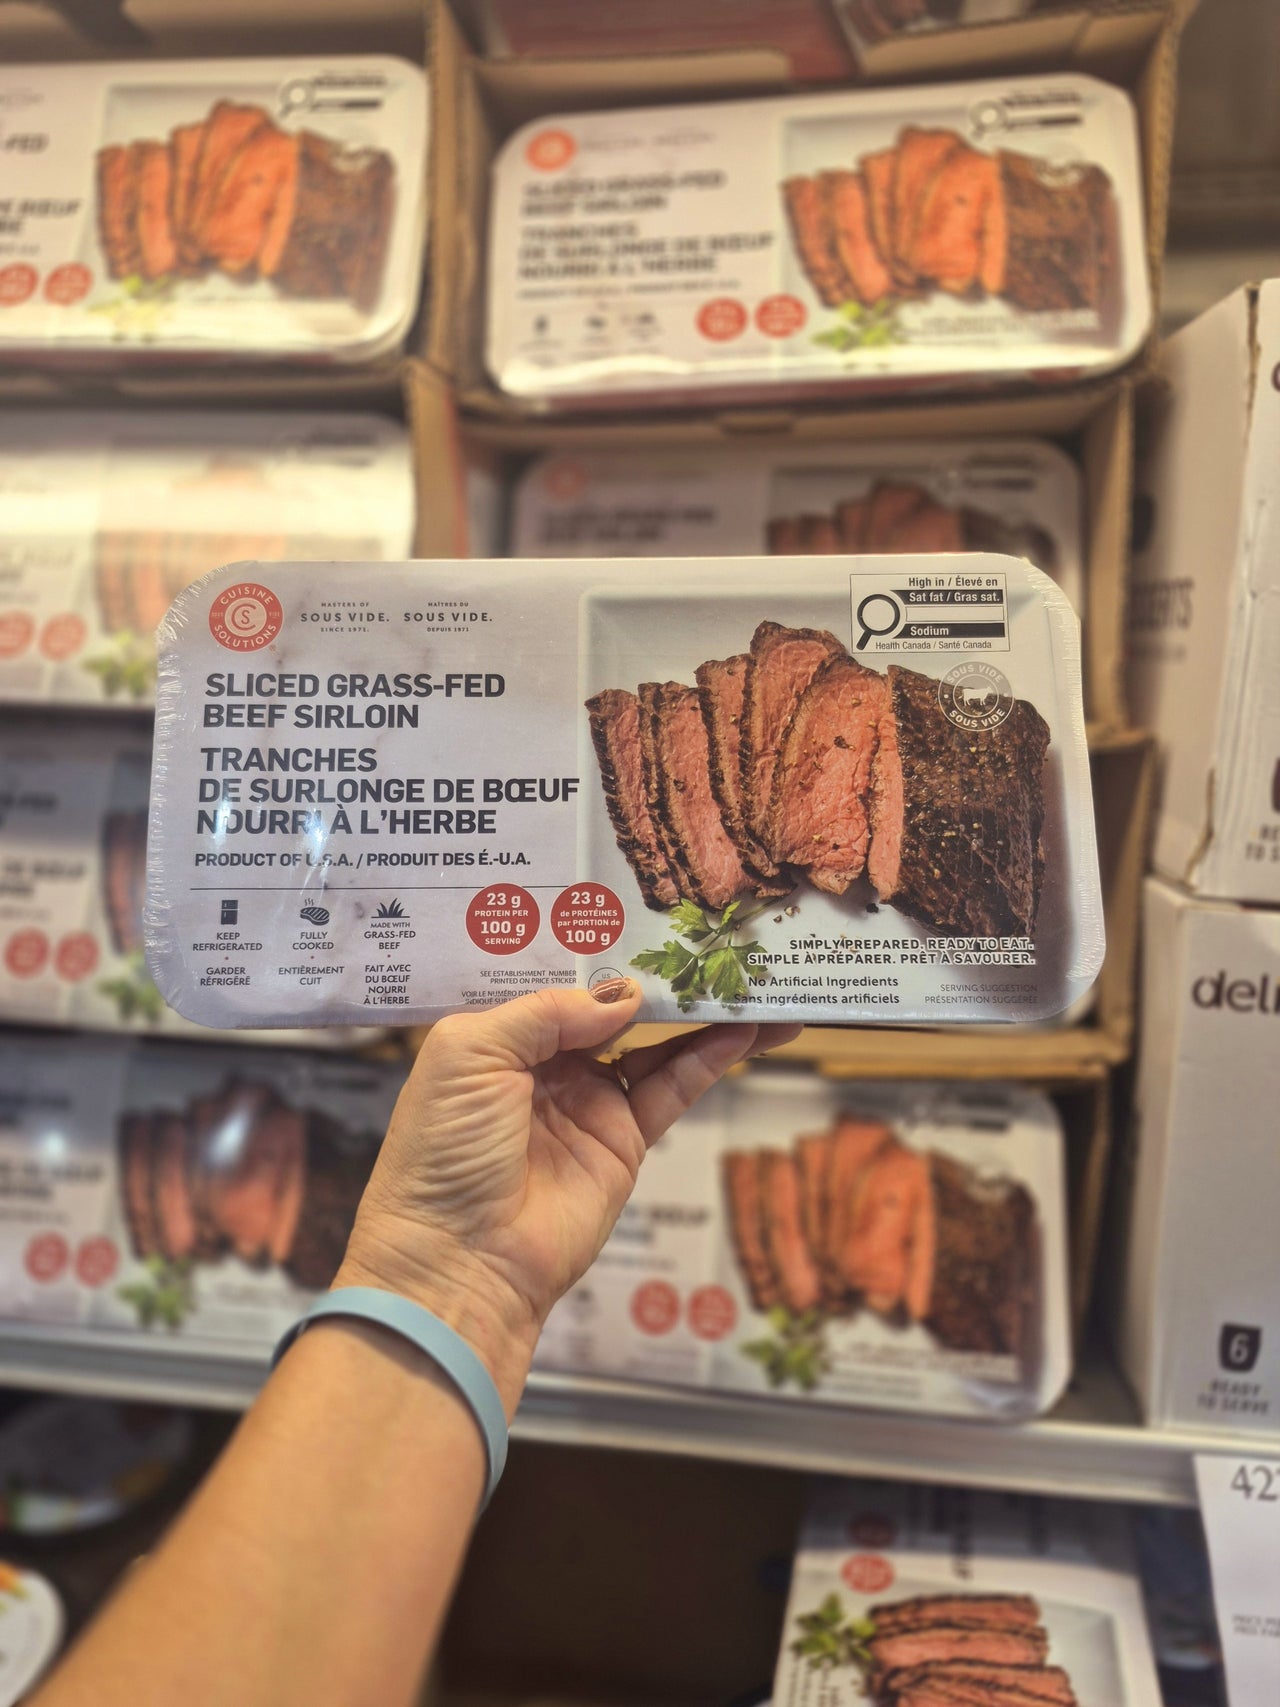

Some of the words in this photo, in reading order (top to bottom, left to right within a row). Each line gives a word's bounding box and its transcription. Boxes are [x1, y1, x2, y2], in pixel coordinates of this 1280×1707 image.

[909, 578, 932, 589] High
[935, 578, 945, 587] in
[956, 575, 982, 587] Élevé
[986, 579, 998, 587] en
[220, 586, 274, 605] CUISINE
[909, 592, 927, 602] Sat
[930, 592, 944, 602] fat
[954, 592, 978, 602] Gras
[980, 592, 1000, 602] sat.
[300, 612, 342, 622] SOUS
[348, 612, 390, 622] VIDE.
[404, 612, 446, 622] SOUS
[452, 612, 494, 622] VIDE.
[910, 626, 950, 636] Sodium
[214, 624, 277, 649] SOLUTIONS
[876, 642, 900, 650] Health
[902, 642, 931, 650] Canada
[938, 640, 961, 650] Santé
[963, 641, 992, 650] Canada
[946, 664, 975, 684] SOUS
[978, 664, 1004, 684] VIDE
[205, 673, 320, 698] SLICED
[327, 674, 506, 698] GRASS-FED
[204, 704, 287, 728] BEEF
[293, 704, 419, 729] SIRLOIN
[950, 710, 978, 728] SOUS
[981, 708, 1006, 727] VIDE
[201, 748, 378, 772] TRANCHES
[199, 779, 242, 803] DE
[249, 779, 425, 803] SURLONGE
[434, 779, 475, 803] DE
[483, 778, 580, 803] BŒUF
[330, 804, 353, 834] À
[360, 810, 496, 834] L'HERBE
[195, 853, 276, 867] PRODUCT
[280, 854, 302, 866] OF
[367, 853, 440, 866] PRODUIT
[443, 853, 475, 866] DES
[479, 849, 532, 866] É.-U.A.
[486, 893, 507, 906] 23
[511, 895, 521, 908] g
[571, 892, 591, 905] 23
[595, 894, 606, 908] g
[572, 909, 618, 917] PROTÉINES
[481, 921, 512, 934] 100
[516, 924, 526, 937] g
[558, 920, 572, 928] par
[216, 932, 240, 941] KEEP
[300, 932, 328, 940] FULLY
[364, 930, 416, 939] GRASS-FED
[566, 930, 596, 943] 100
[600, 933, 611, 946] g
[193, 943, 263, 952] REFRIGERATED
[292, 942, 334, 950] COOKED
[378, 942, 401, 950] BEEF
[790, 939, 840, 950] SIMPLY
[846, 939, 924, 950] PREPARED.
[928, 939, 974, 950] READY
[980, 939, 998, 950] TO
[1001, 939, 1034, 950] EAT.
[749, 954, 800, 964] SIMPLE
[804, 951, 814, 964] À
[818, 952, 896, 964] PRÉPARER.
[901, 951, 937, 964] PRÊT
[941, 951, 951, 964] À
[954, 954, 1035, 964] SAVOURER.
[206, 967, 246, 976] GARDER
[278, 964, 345, 975] ENTIÈREMENT
[365, 964, 385, 973] FAIT
[386, 964, 412, 972] AVEC
[480, 970, 492, 978] SEE
[200, 976, 251, 986] RÉFRIGÉRÉ
[300, 977, 322, 986] CUIT
[365, 975, 380, 984] DU
[381, 975, 411, 983] BŒUF
[749, 976, 767, 987] No
[770, 976, 823, 987] Artificial
[827, 976, 899, 989] Ingredients
[368, 986, 406, 994] NOURRI
[940, 984, 979, 992] SERVING
[980, 984, 1038, 992] SUGGESTION
[364, 995, 372, 1005] À
[373, 996, 410, 1004] L'HERBE
[734, 994, 762, 1004] Sans
[766, 993, 838, 1006] ingrédients
[841, 993, 900, 1004] artificiels
[925, 995, 990, 1004] PRÉSENTATION
[1230, 1464, 1280, 1502] 42
